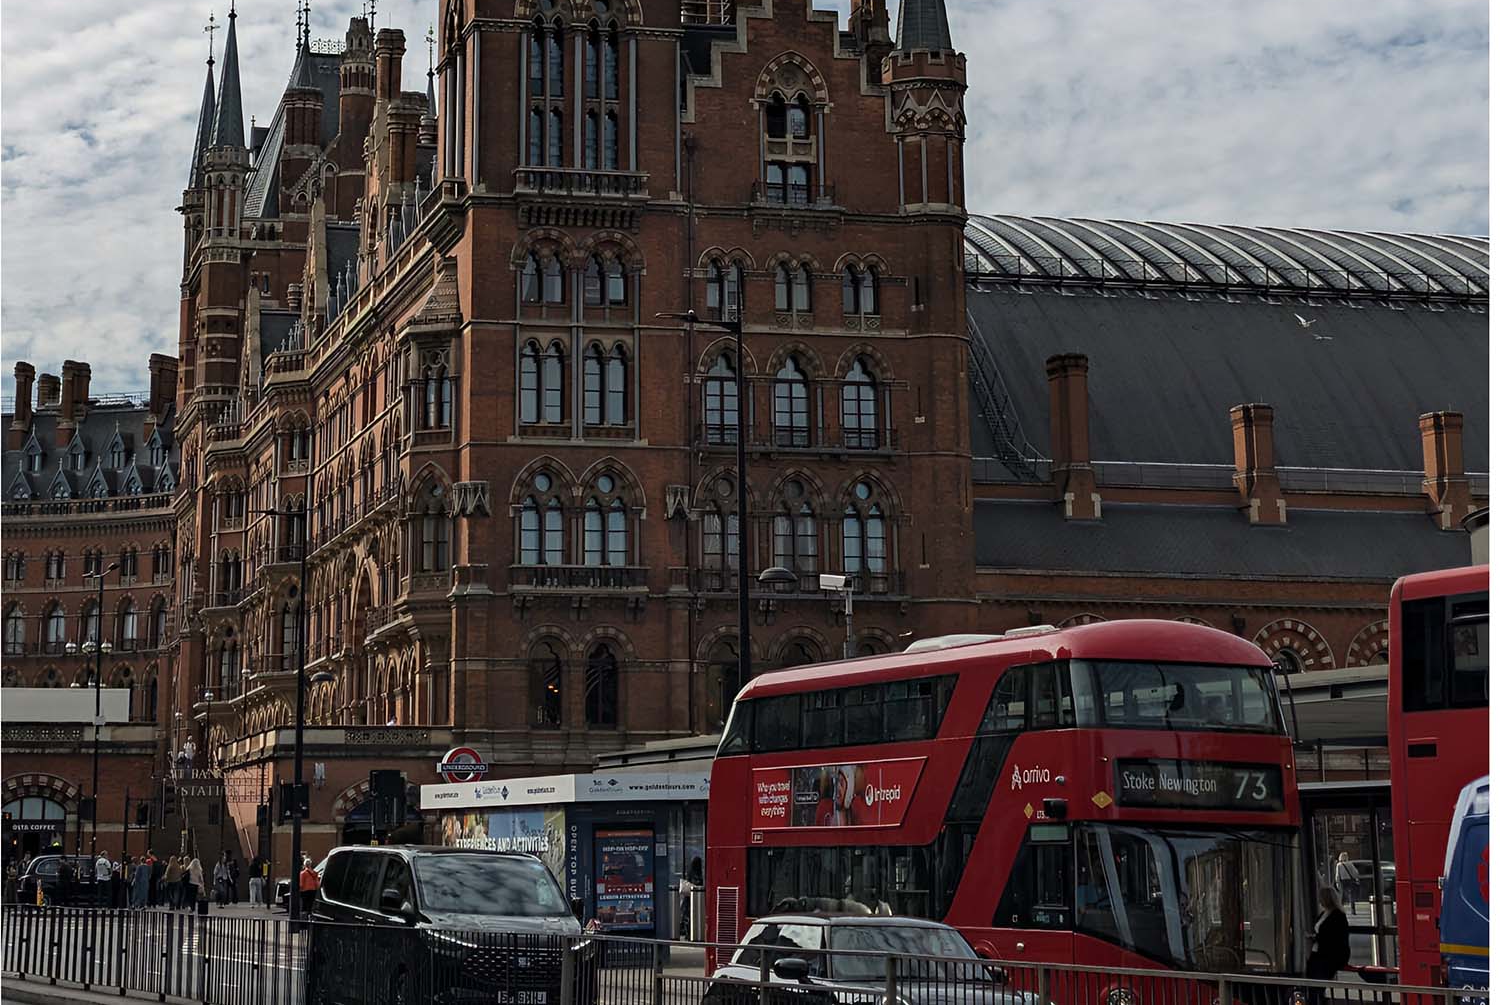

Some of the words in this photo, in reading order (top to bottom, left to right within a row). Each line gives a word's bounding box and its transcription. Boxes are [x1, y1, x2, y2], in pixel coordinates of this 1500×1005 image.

[1022, 768, 1051, 783] arriva
[1123, 771, 1155, 790] Stoke
[1159, 772, 1217, 795] Newington
[1234, 772, 1267, 800] 73
[873, 784, 901, 803] Intrepid
